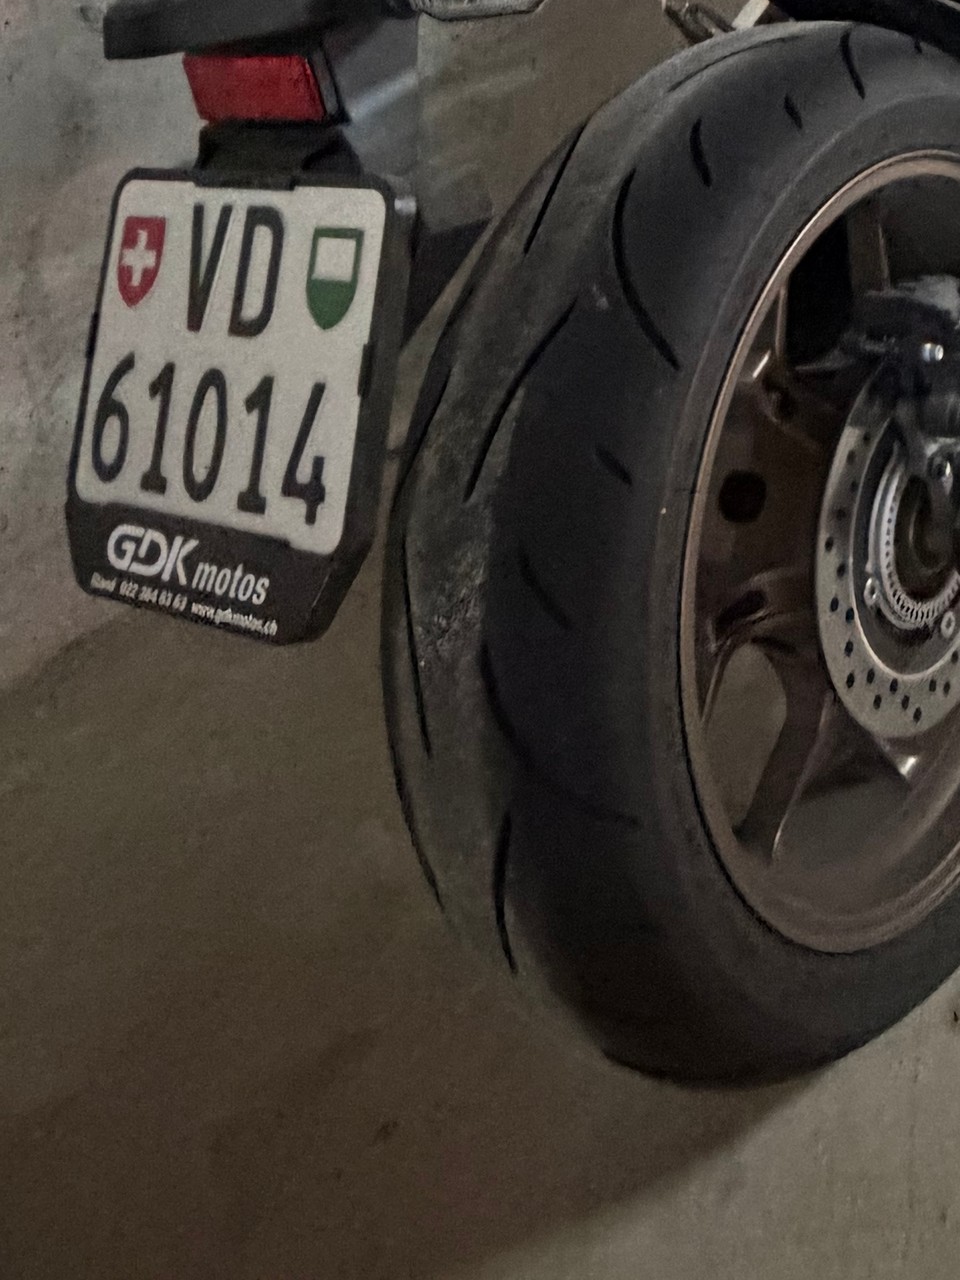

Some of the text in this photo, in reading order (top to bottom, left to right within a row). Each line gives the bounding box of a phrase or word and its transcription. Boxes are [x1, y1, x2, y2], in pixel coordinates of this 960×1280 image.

[187, 204, 285, 338] VD
[91, 352, 326, 526] 61014
[107, 523, 199, 586] GDK
[191, 561, 270, 606] motos
